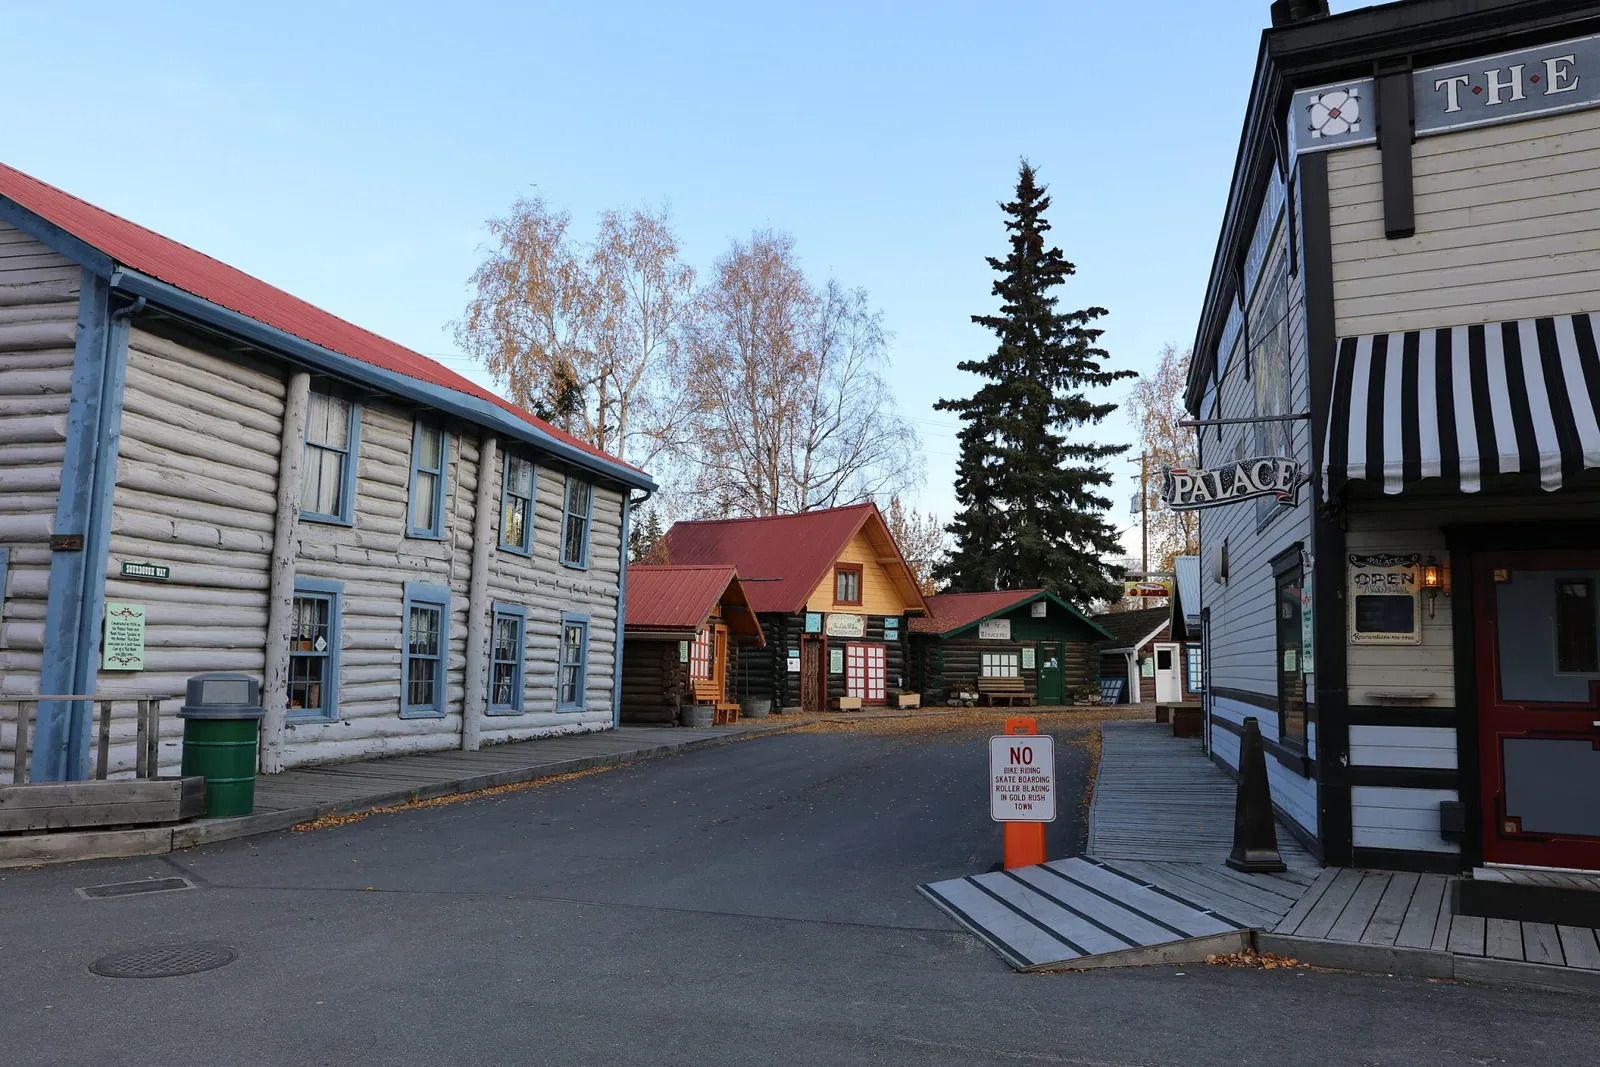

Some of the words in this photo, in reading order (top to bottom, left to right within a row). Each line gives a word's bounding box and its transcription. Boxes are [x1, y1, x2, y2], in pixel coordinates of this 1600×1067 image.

[1172, 459, 1296, 505] PALACE
[156, 567, 166, 577] WAY
[1354, 573, 1414, 585] OPEN
[1010, 746, 1033, 765] NO
